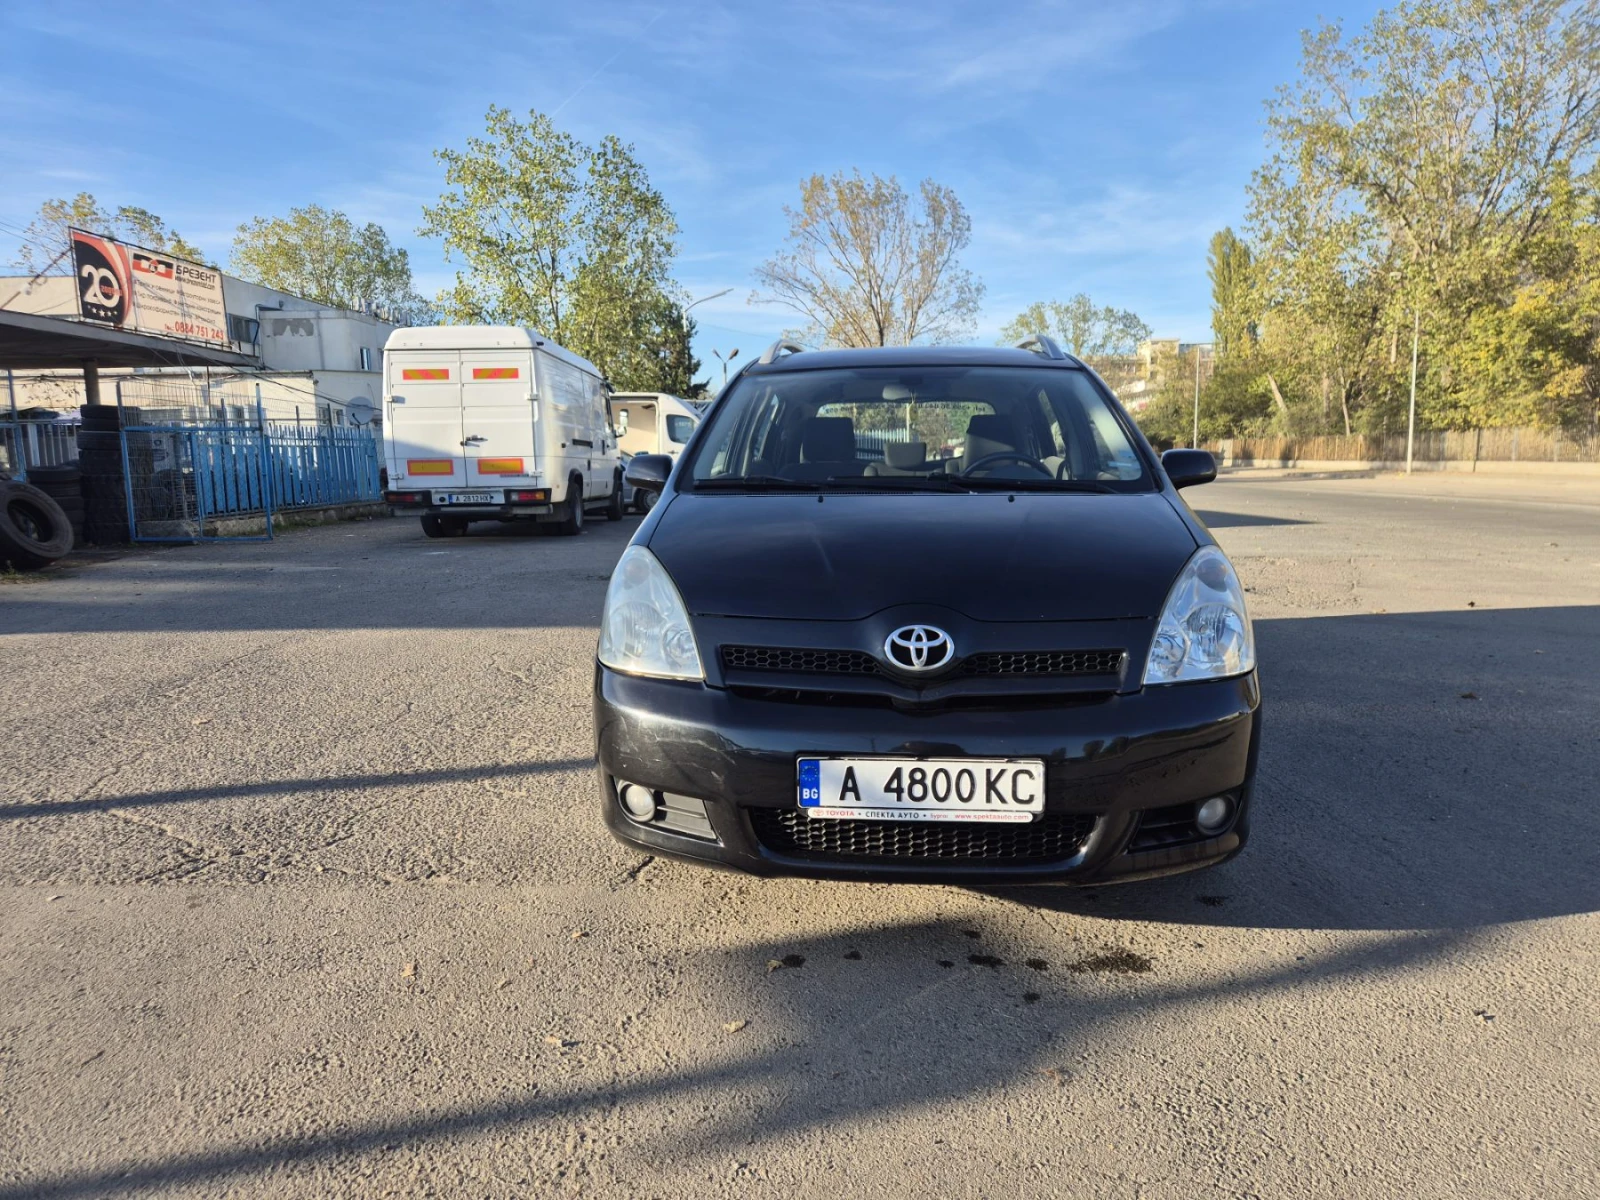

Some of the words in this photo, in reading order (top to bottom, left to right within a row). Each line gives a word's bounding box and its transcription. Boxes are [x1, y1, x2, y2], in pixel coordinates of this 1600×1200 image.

[175, 264, 217, 284] БРЕЗЕНТ
[82, 264, 120, 308] 20
[196, 325, 209, 337] 751
[802, 788, 819, 800] BG
[839, 765, 861, 801] A
[883, 766, 976, 803] 4800
[985, 768, 1036, 805] KC
